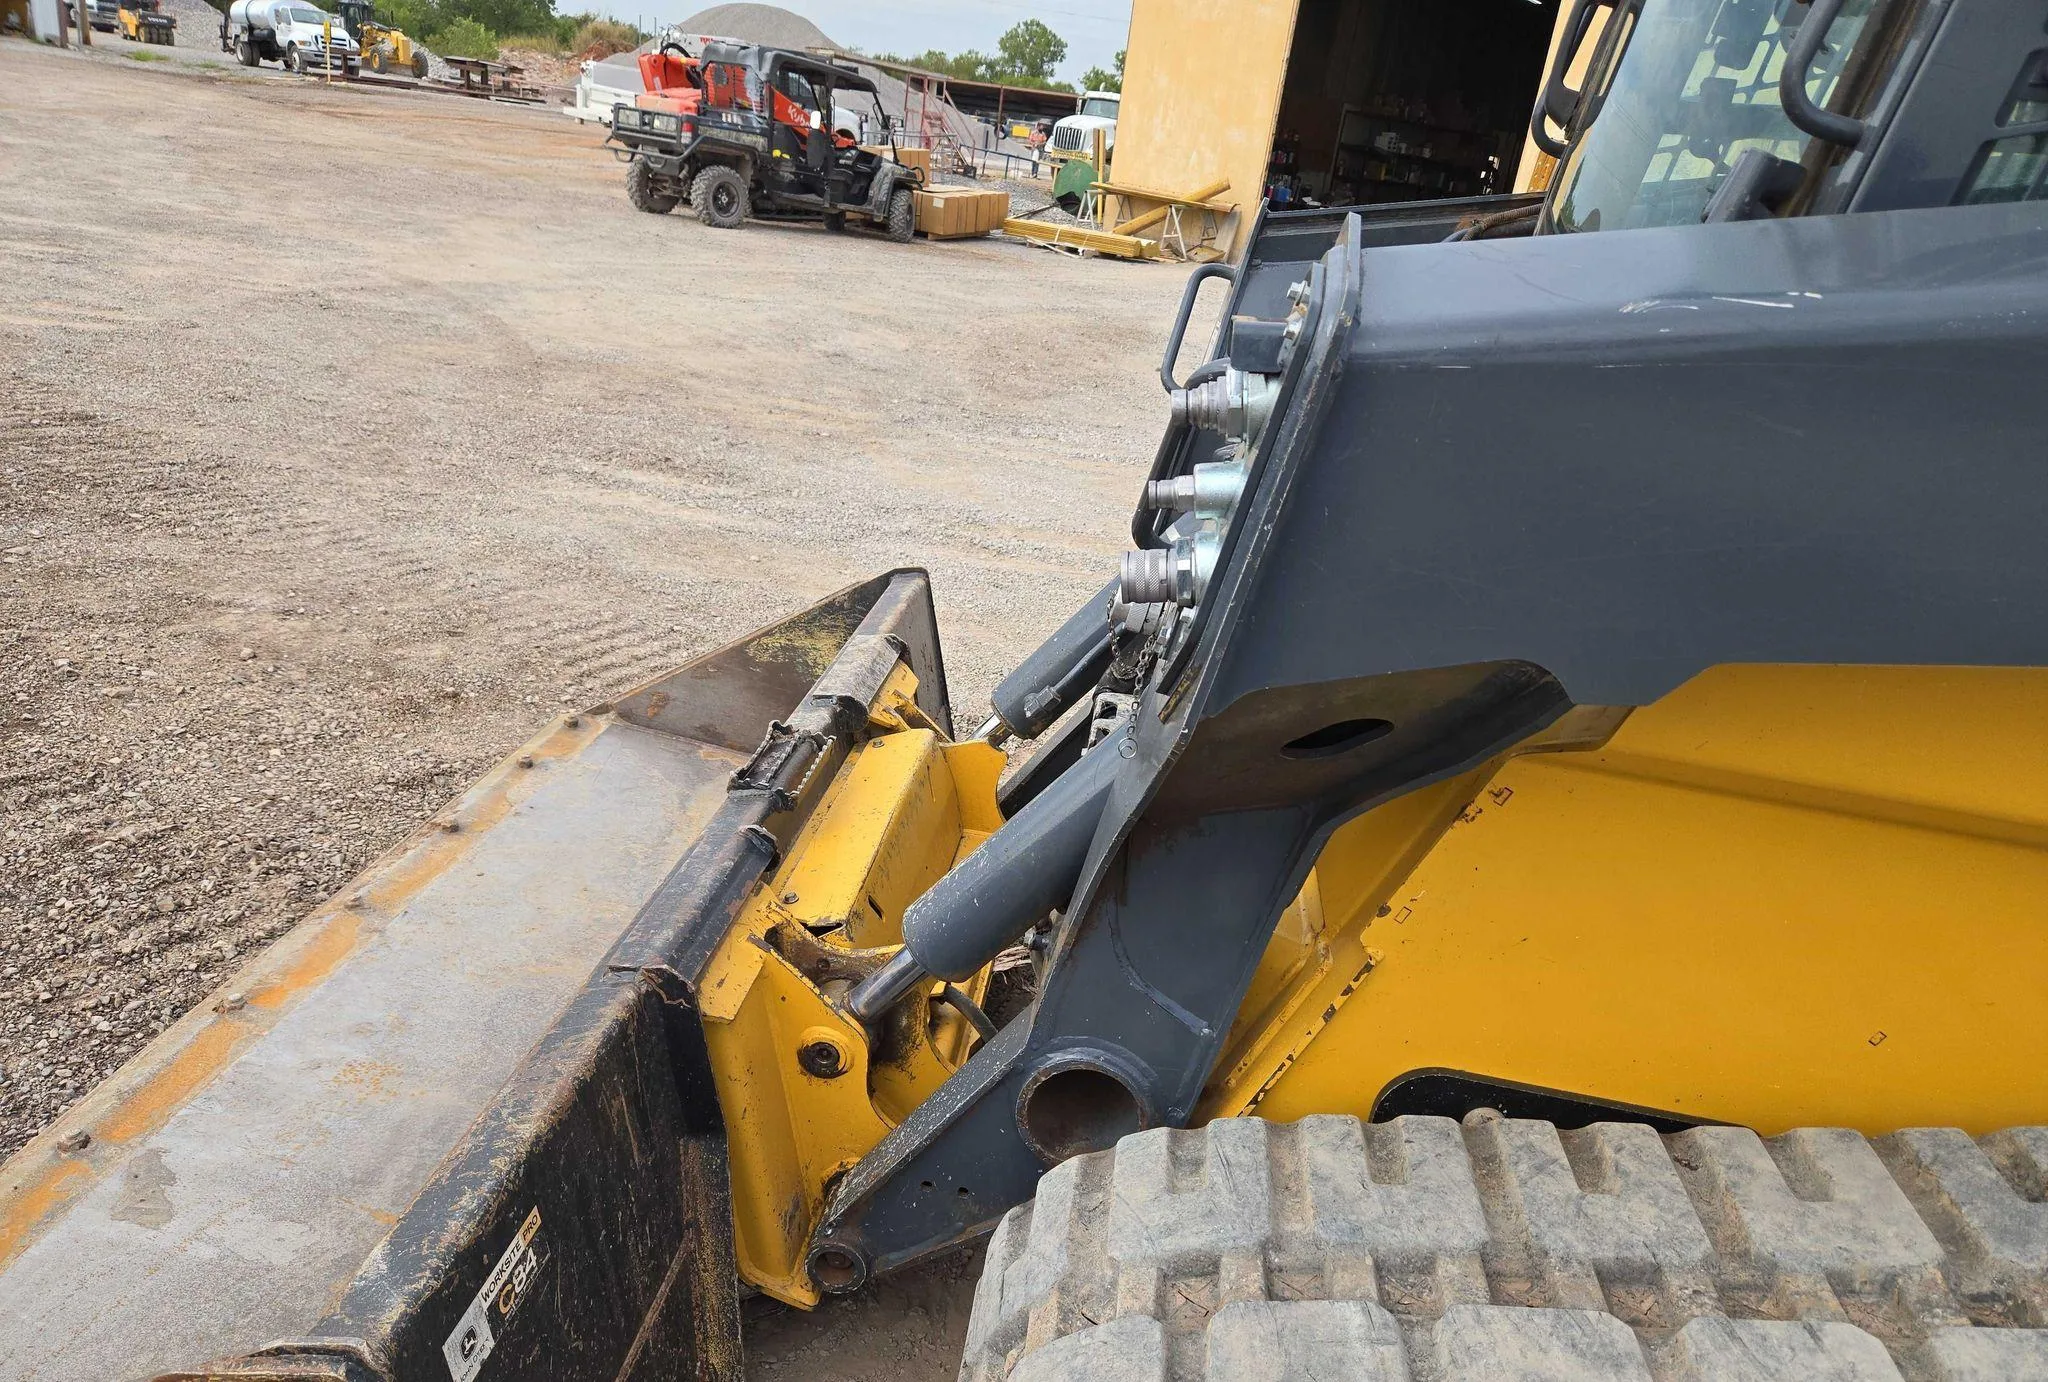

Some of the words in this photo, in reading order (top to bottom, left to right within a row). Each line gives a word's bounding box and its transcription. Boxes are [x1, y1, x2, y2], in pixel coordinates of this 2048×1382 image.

[481, 1240, 522, 1302] WORKSITE
[522, 1214, 538, 1241] PRO
[499, 1247, 538, 1314] C84
